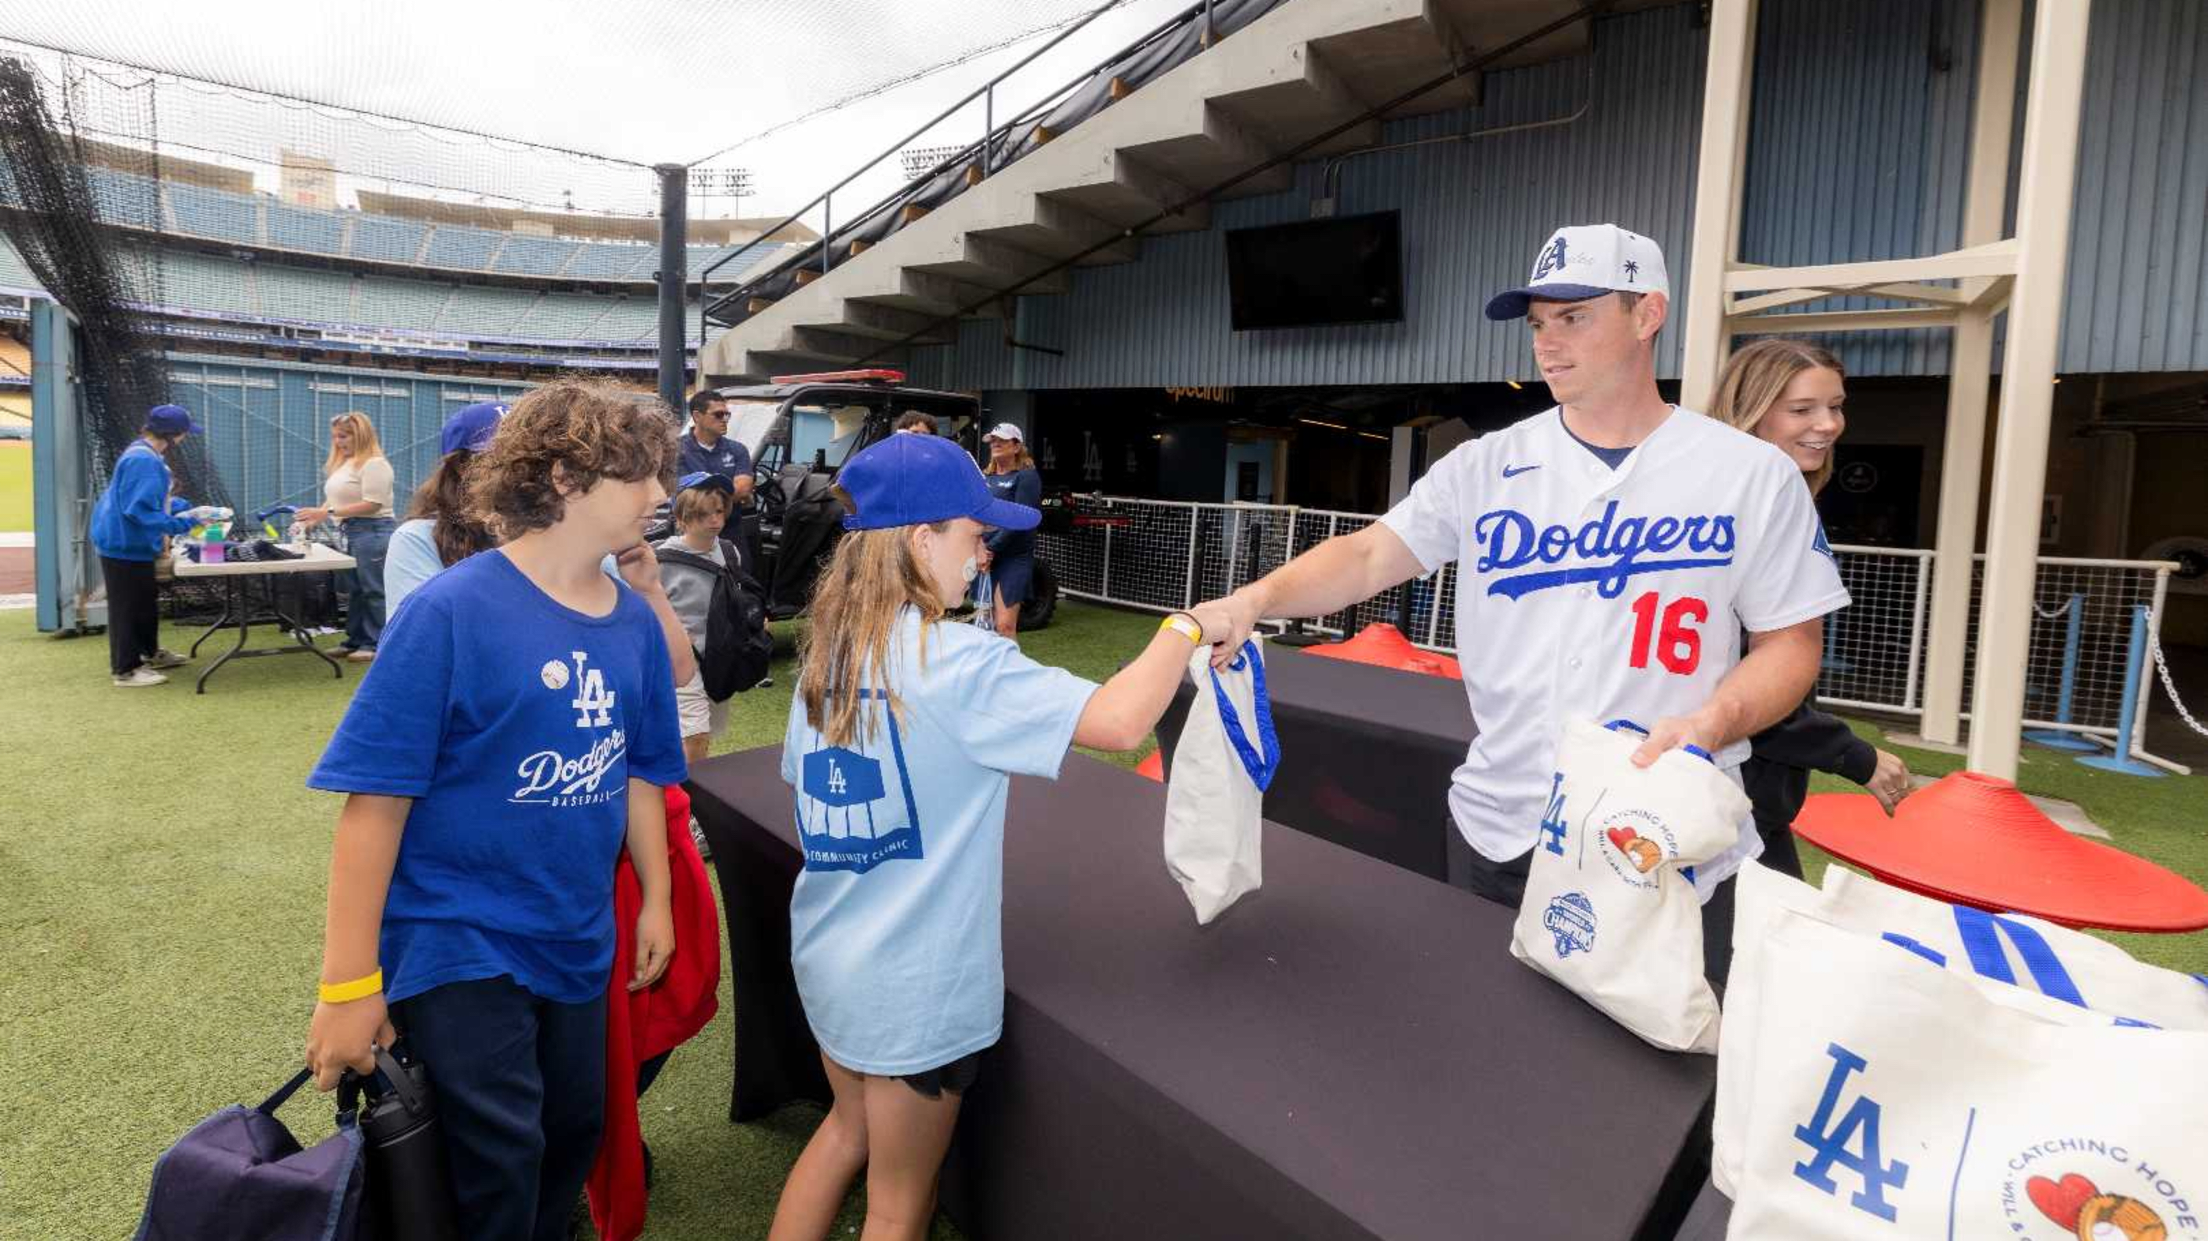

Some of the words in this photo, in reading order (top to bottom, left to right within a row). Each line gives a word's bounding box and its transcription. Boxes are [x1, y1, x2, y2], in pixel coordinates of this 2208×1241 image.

[1475, 500, 1734, 599] Dodgers
[1630, 592, 1708, 675] 16
[572, 651, 615, 727] LA
[515, 728, 626, 799] Dodgers
[551, 790, 610, 807] BASEBALL
[828, 758, 847, 793] LA
[810, 850, 868, 864] COMMUNITY
[872, 839, 909, 860] CLINIC
[1793, 1042, 1909, 1223] LA
[2008, 1138, 2129, 1172] CATCHING
[2135, 1162, 2199, 1230] HOPE
